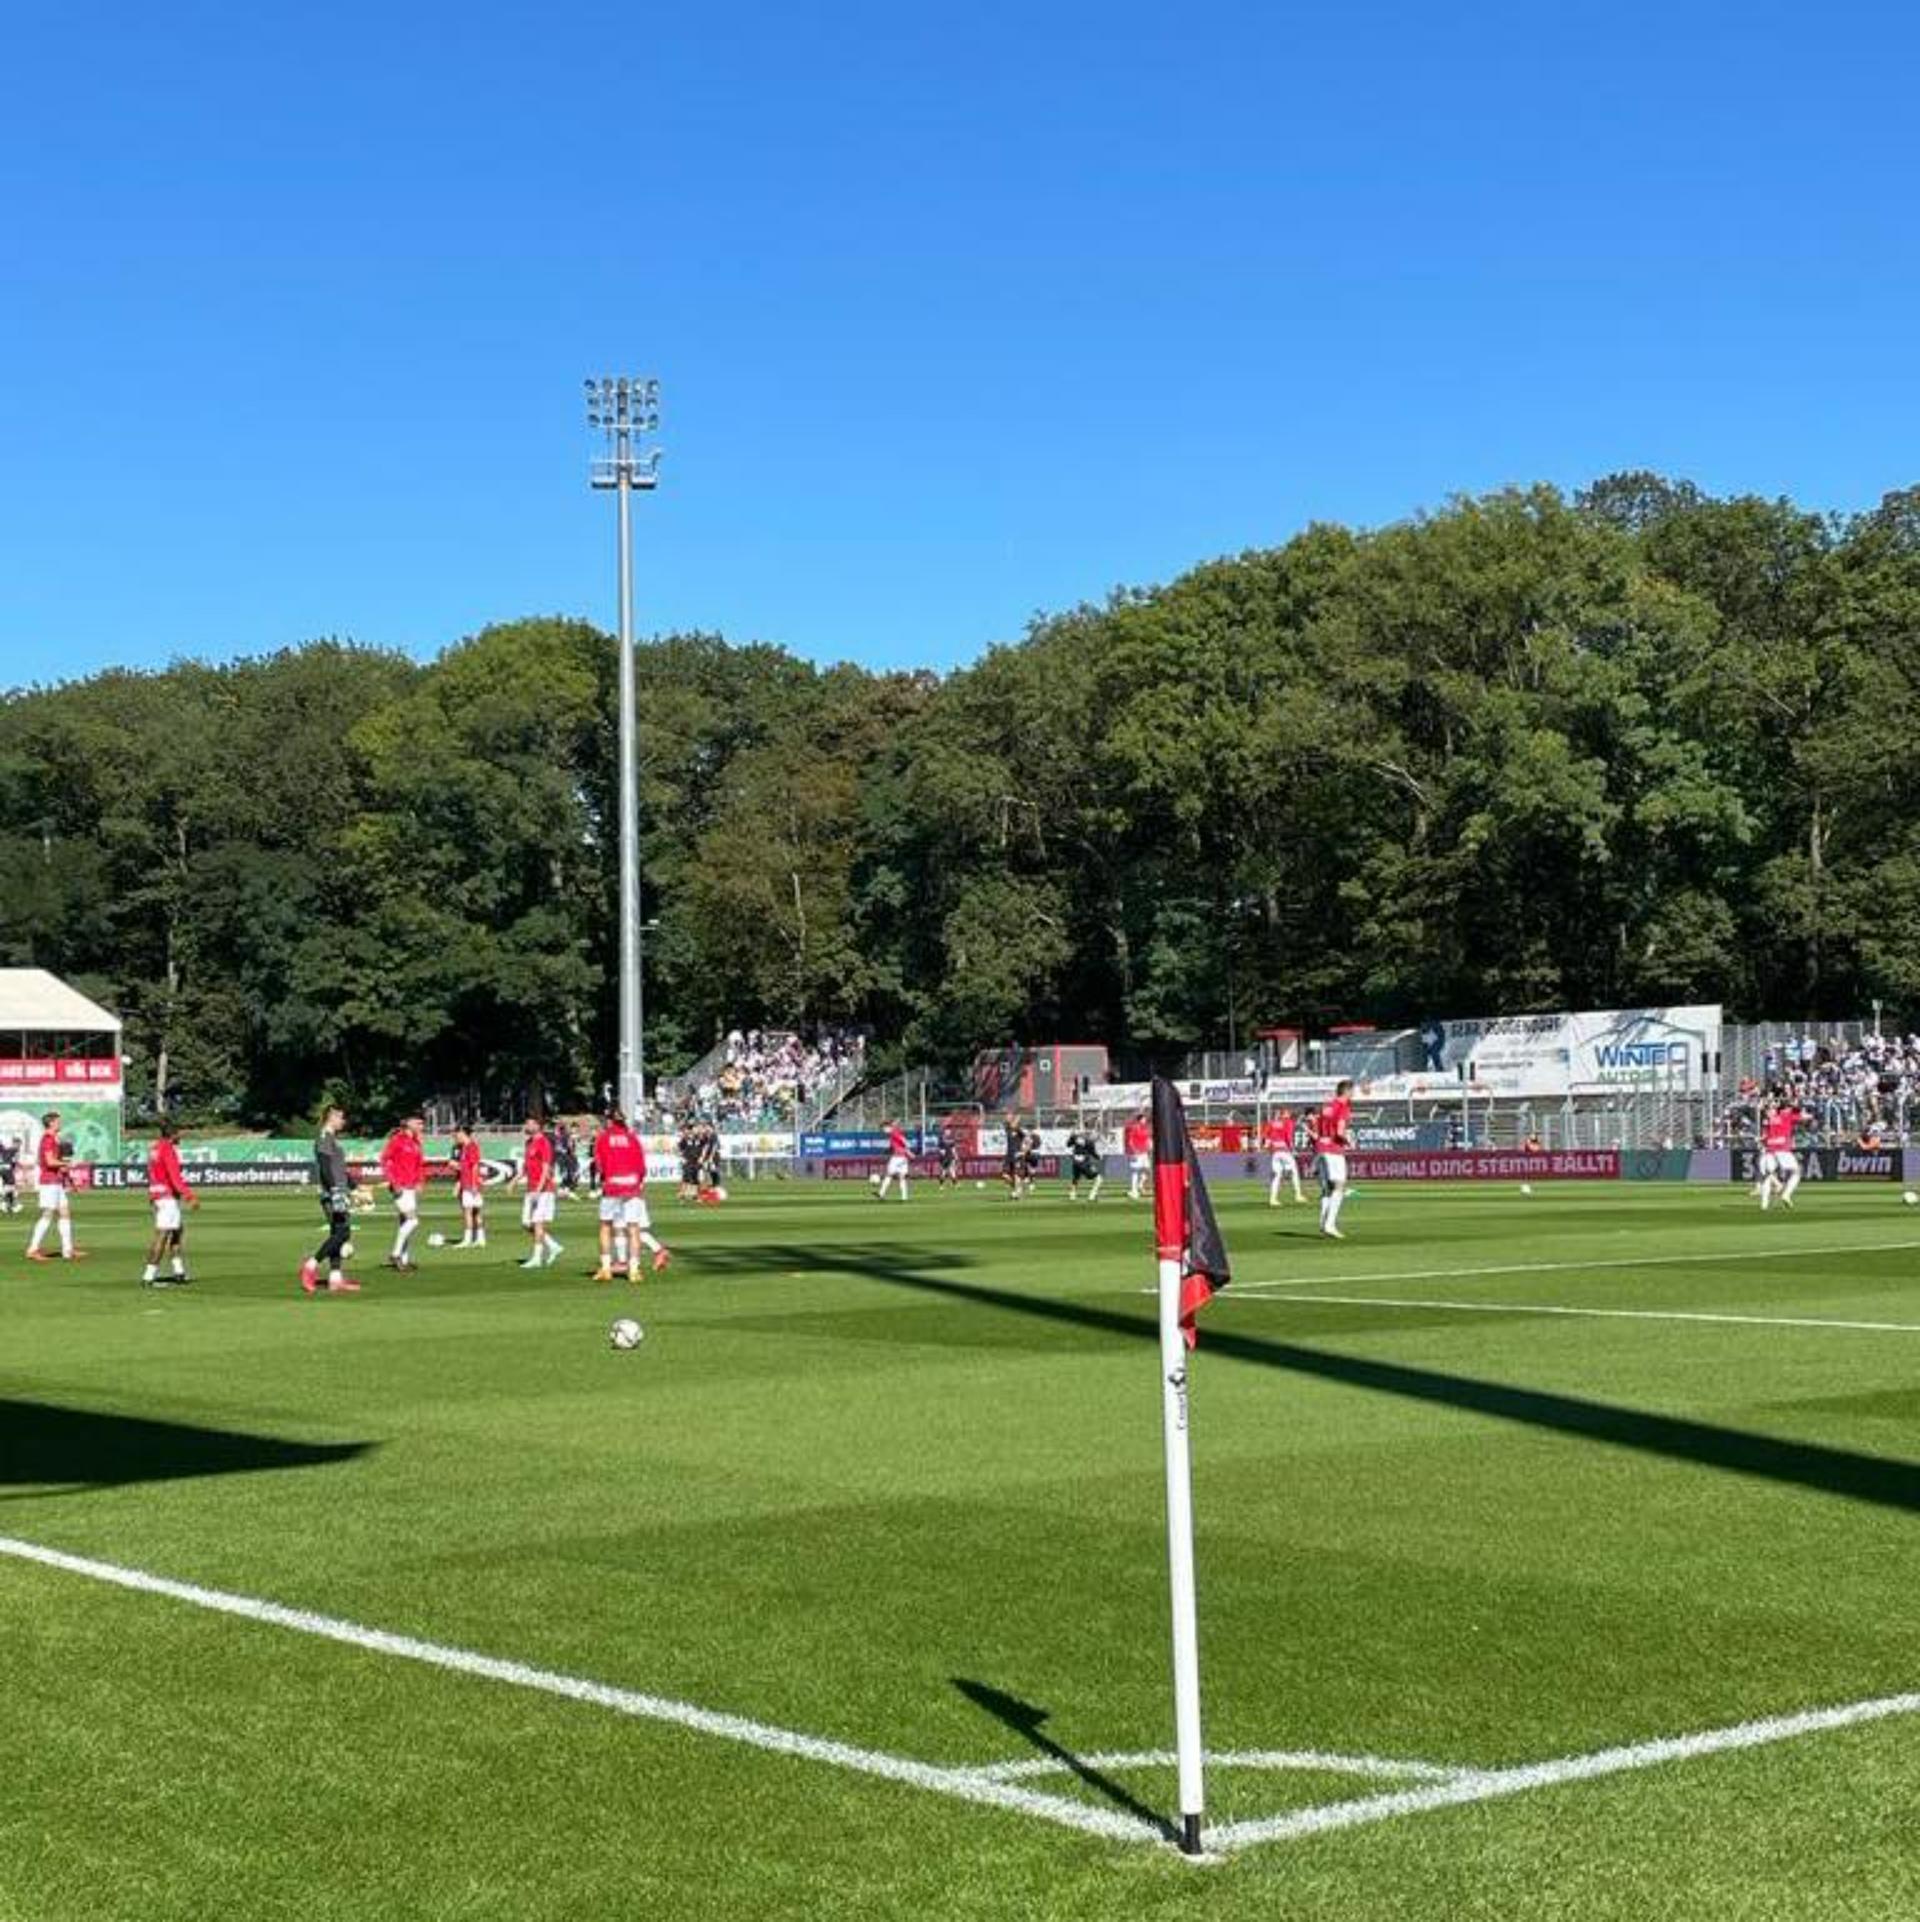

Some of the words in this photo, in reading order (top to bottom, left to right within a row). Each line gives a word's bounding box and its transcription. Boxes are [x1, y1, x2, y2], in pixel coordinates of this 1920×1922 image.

[1837, 1152, 1892, 1174] bwin
[94, 1168, 125, 1185] ETL
[204, 1167, 309, 1183] Steuerberatung
